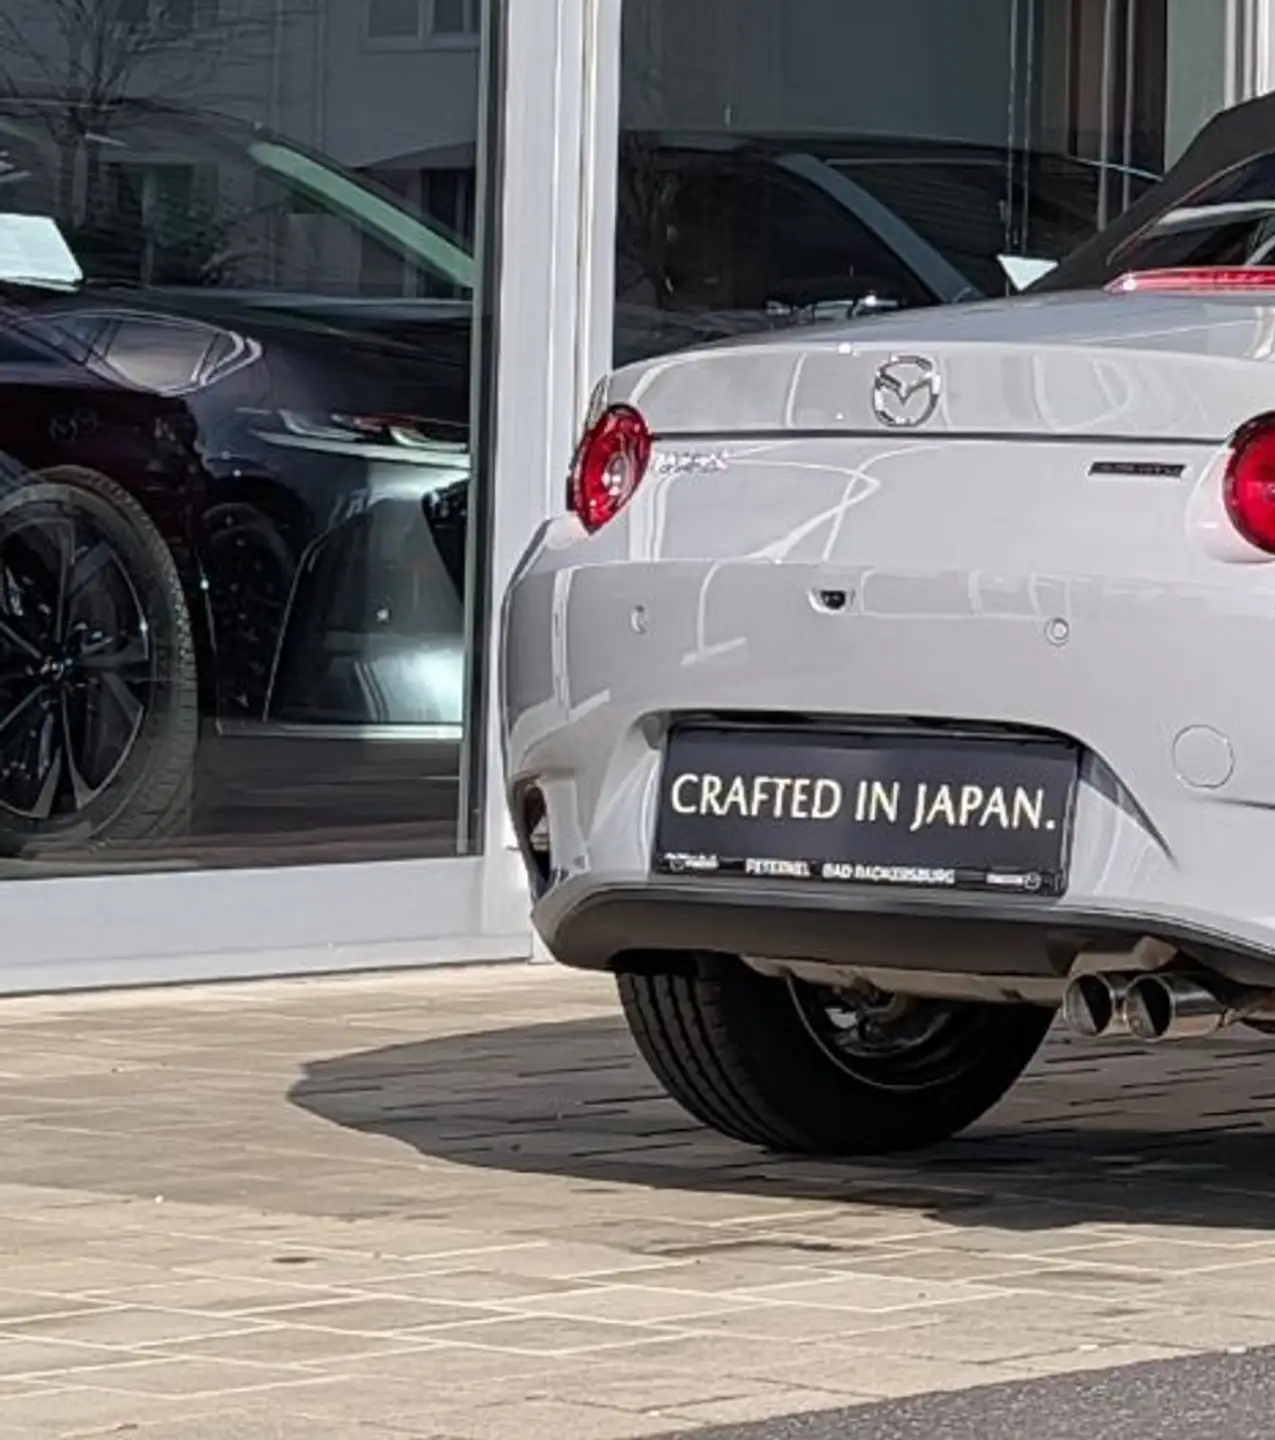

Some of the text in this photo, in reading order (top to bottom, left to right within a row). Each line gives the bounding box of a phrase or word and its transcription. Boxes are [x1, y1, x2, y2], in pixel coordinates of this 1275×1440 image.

[671, 773, 1056, 832] CRAFTED IN JAPAN.
